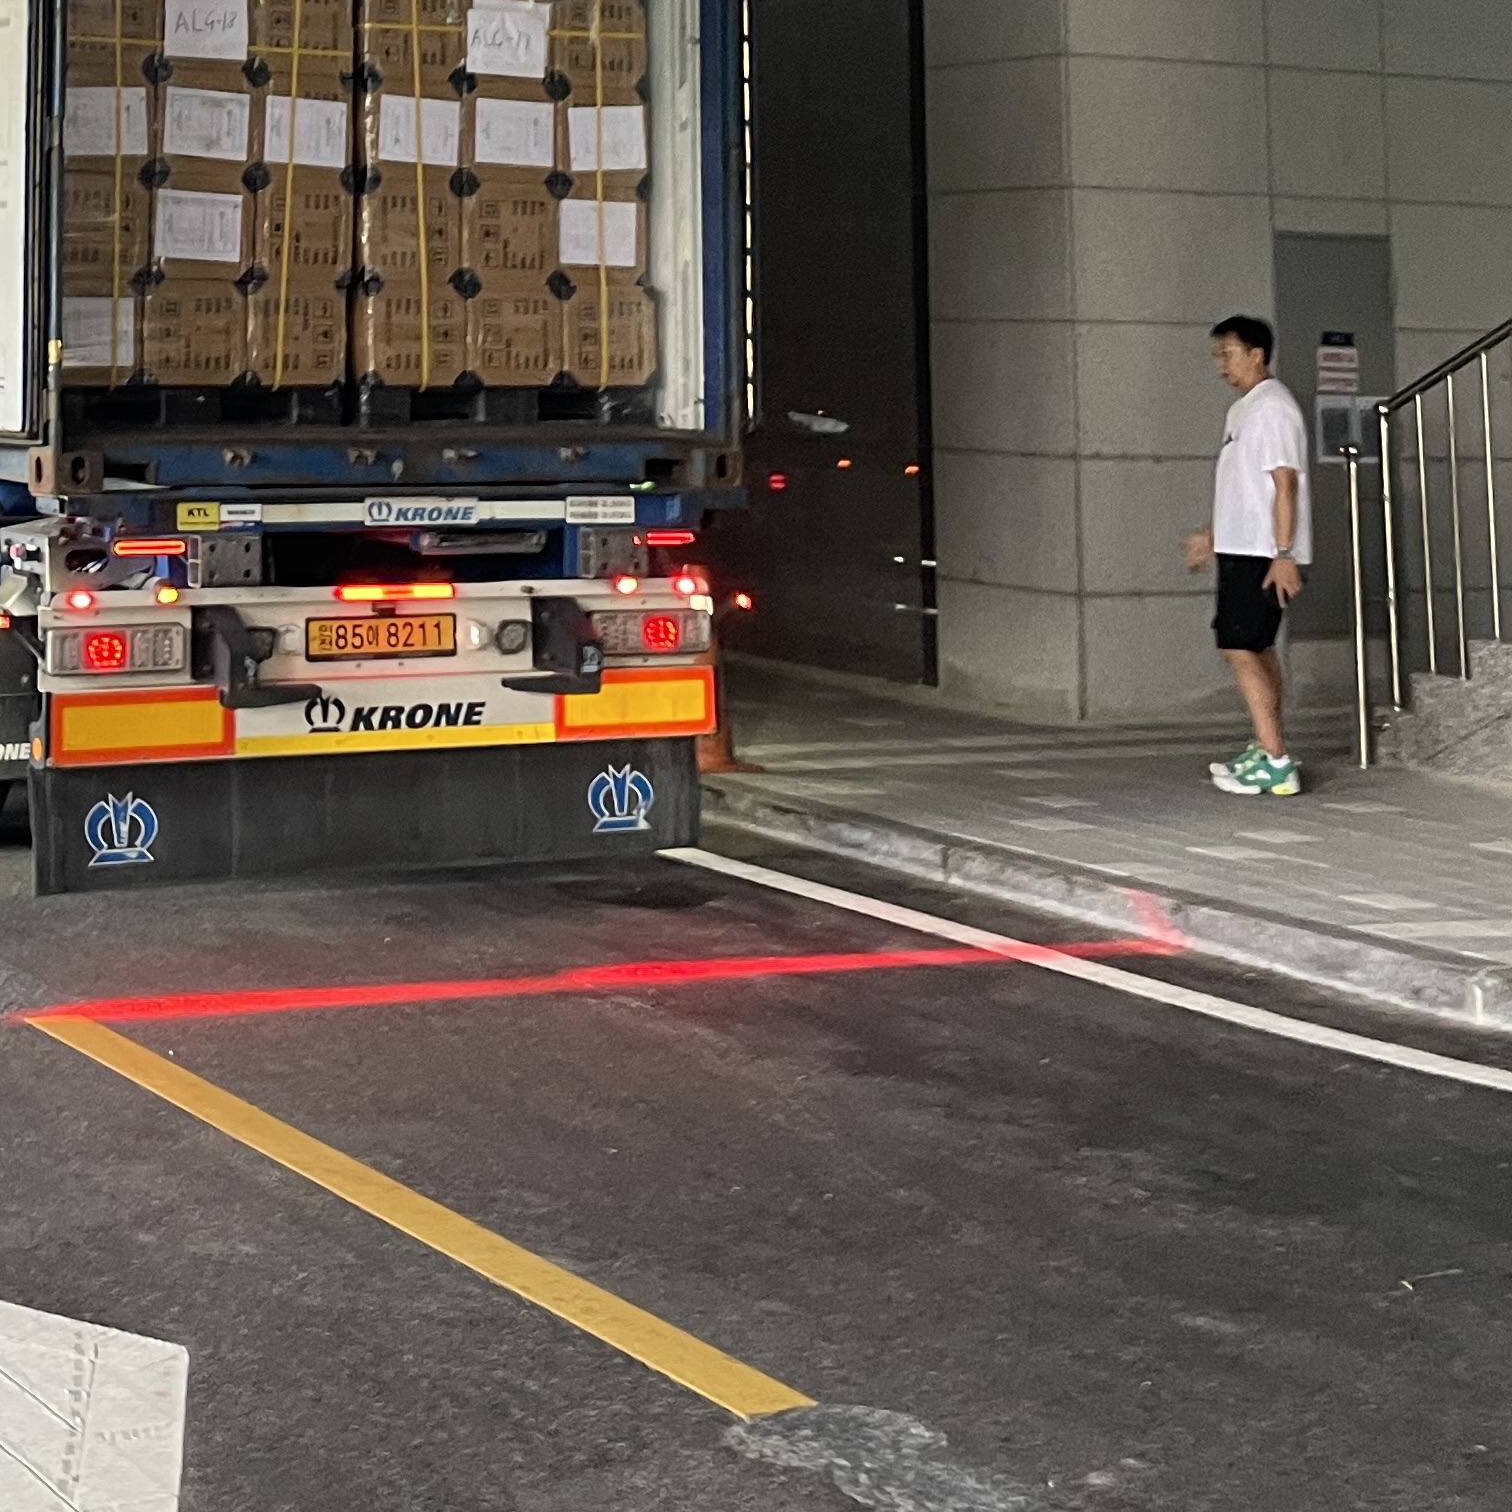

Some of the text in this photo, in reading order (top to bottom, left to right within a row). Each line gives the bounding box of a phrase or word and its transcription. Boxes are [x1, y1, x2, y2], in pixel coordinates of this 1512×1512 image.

[187, 507, 210, 517] KTL
[394, 506, 475, 522] KRONE
[386, 620, 443, 648] 8211
[349, 701, 486, 732] KRONE
